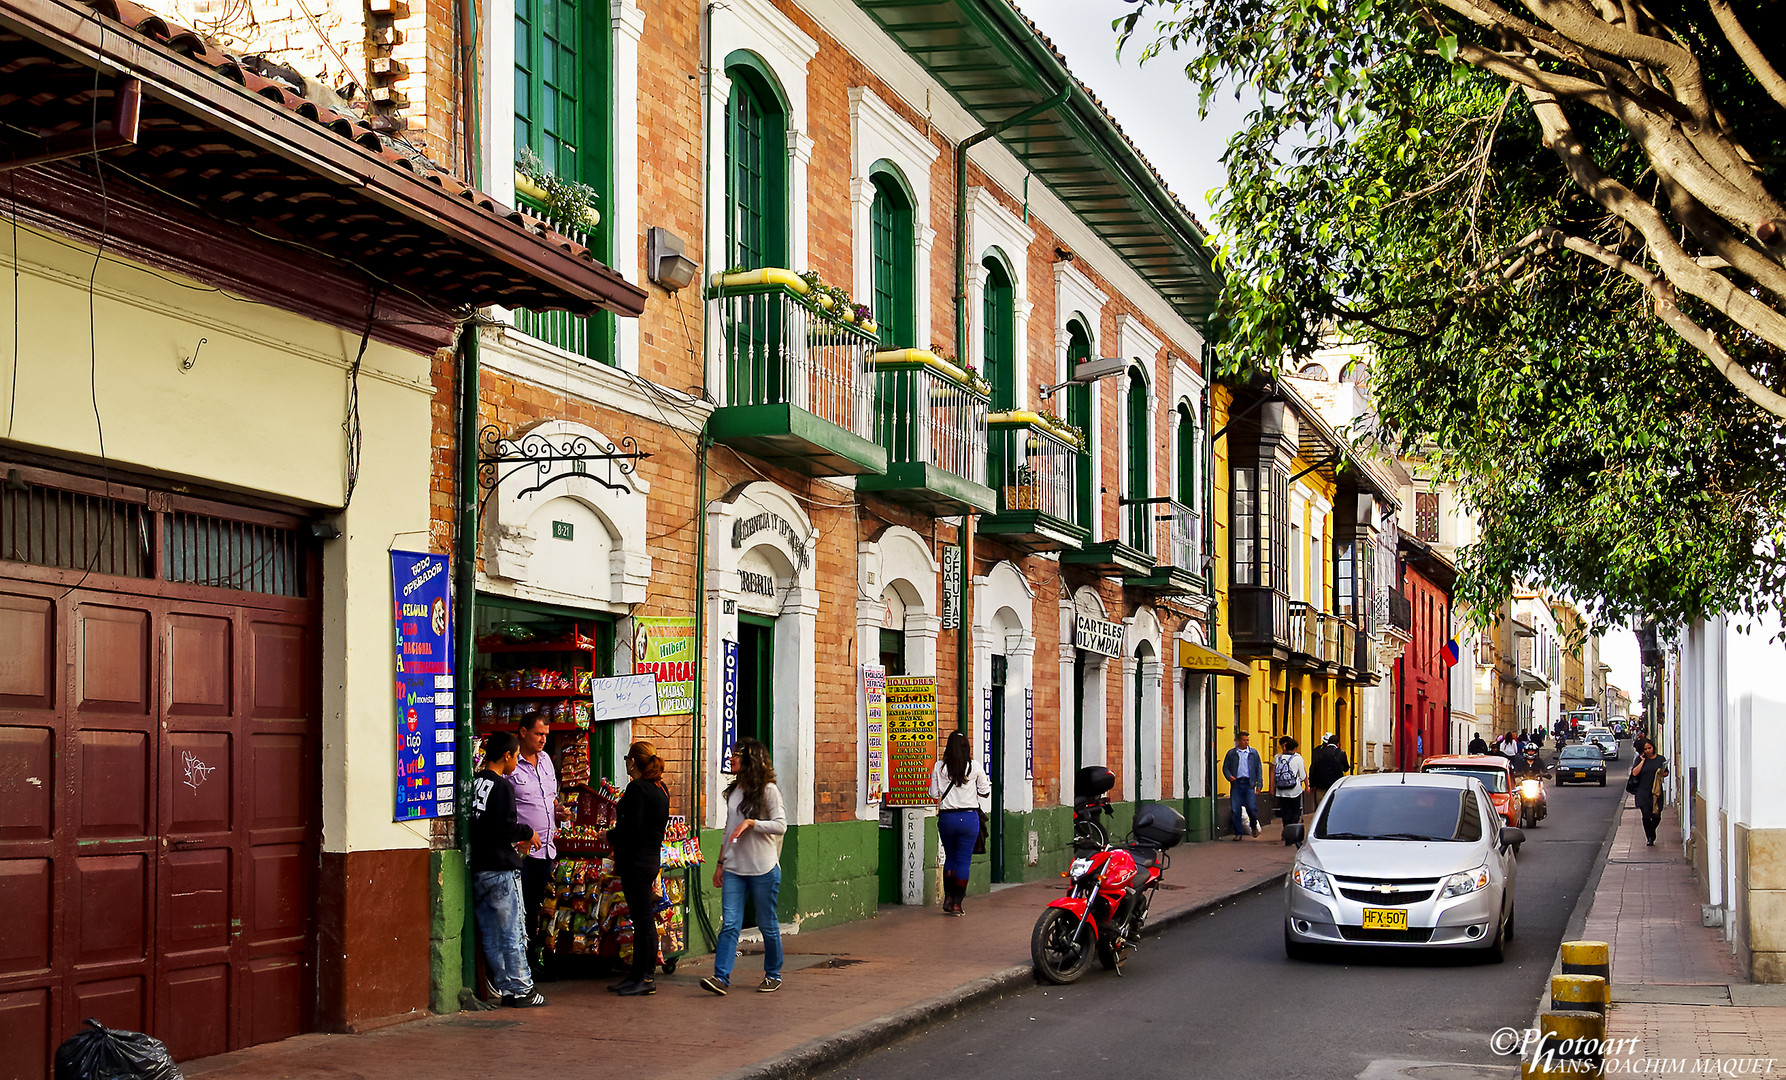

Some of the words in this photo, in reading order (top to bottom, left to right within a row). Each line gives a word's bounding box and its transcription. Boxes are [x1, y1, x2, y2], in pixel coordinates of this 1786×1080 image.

[410, 555, 431, 576] TODO
[402, 561, 443, 597] OPERADOR
[943, 547, 952, 627] HOJALDRES
[402, 603, 428, 617] CELULAR
[403, 622, 418, 635] FIJO
[1078, 616, 1123, 639] CARTELES
[659, 638, 687, 658] Hilbert
[1077, 630, 1119, 657] OLYMPIA
[1186, 656, 1222, 666] CAFE
[887, 678, 934, 686] HOJALDRES
[616, 692, 631, 701] HOY
[658, 684, 685, 698] AMADAS
[416, 694, 434, 704] movistar
[596, 700, 608, 717] 5
[638, 695, 652, 715] 6
[662, 697, 694, 711] OPERADO
[723, 642, 736, 772] FOTOCOPIAS
[407, 805, 426, 817] Italia
[907, 812, 916, 899] CREMAVENA
[1364, 911, 1406, 924] HFX-507
